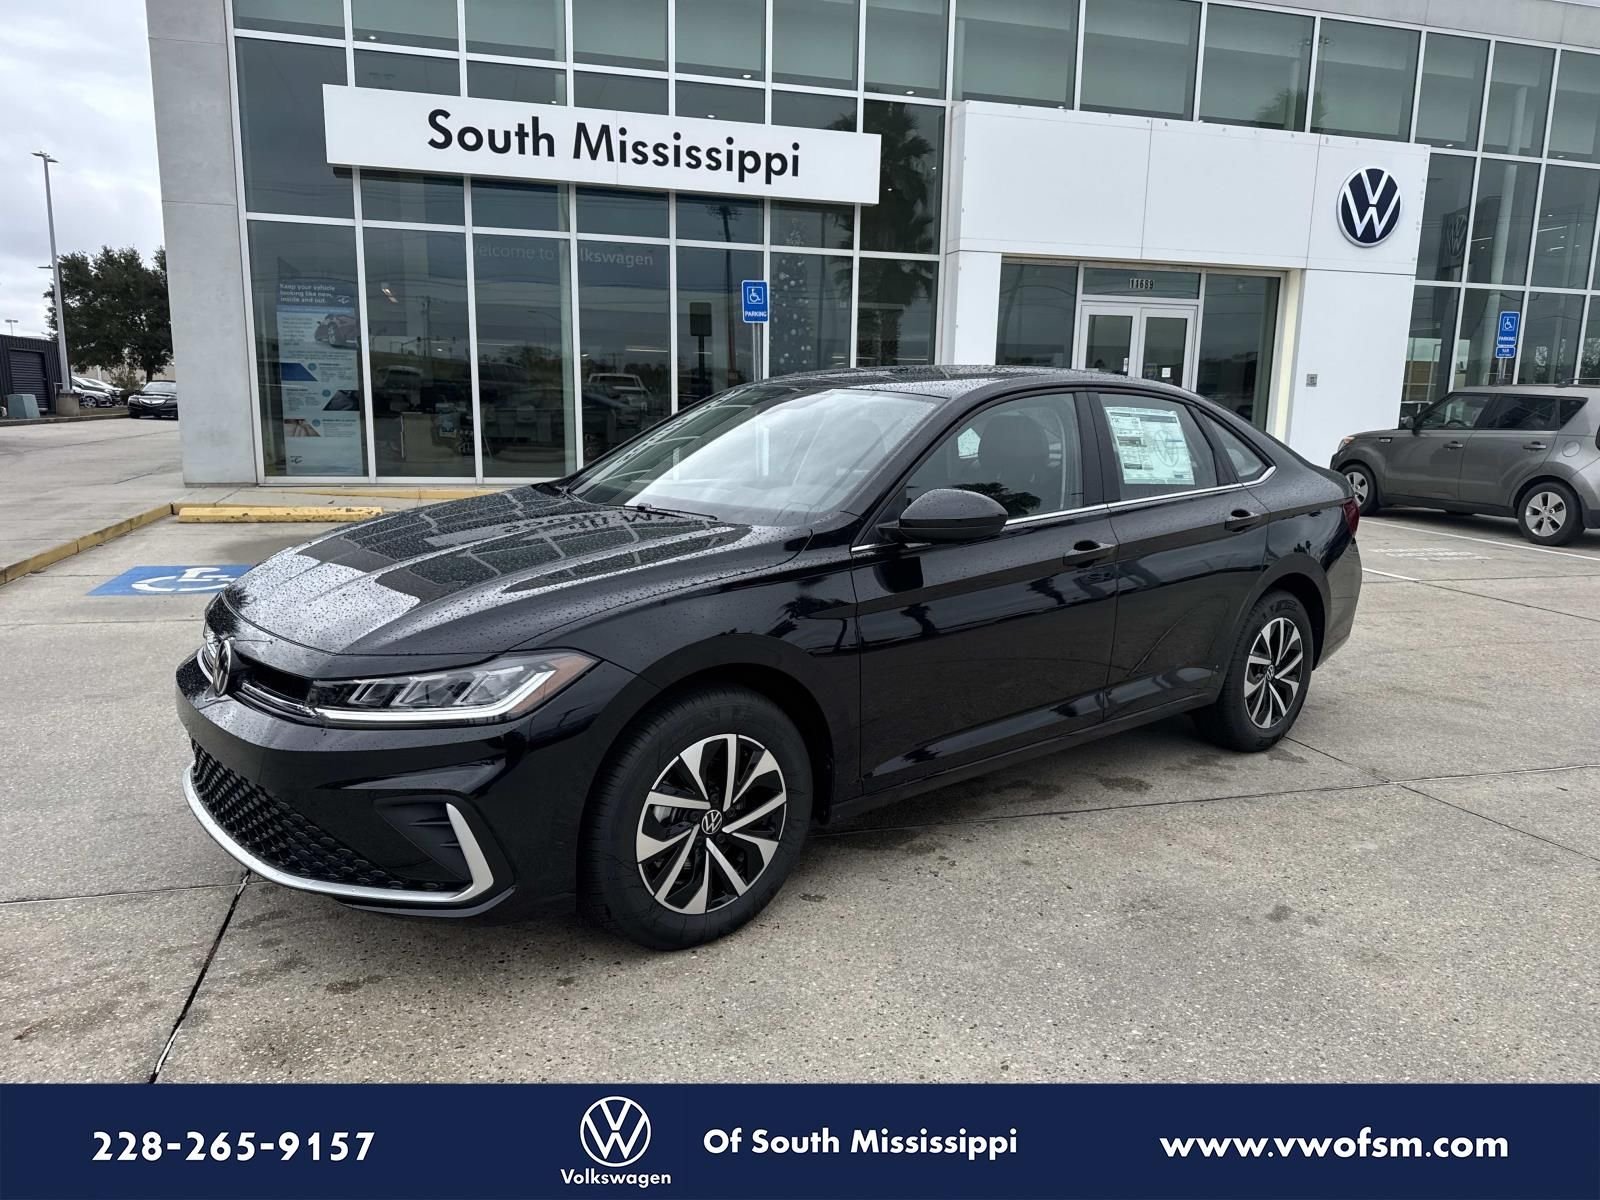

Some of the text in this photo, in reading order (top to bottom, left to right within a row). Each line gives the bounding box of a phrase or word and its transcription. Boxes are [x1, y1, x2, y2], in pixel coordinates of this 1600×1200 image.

[428, 108, 800, 184] South Mississippi
[474, 242, 654, 268] elcome to lkswagen
[1129, 278, 1153, 289] 11689
